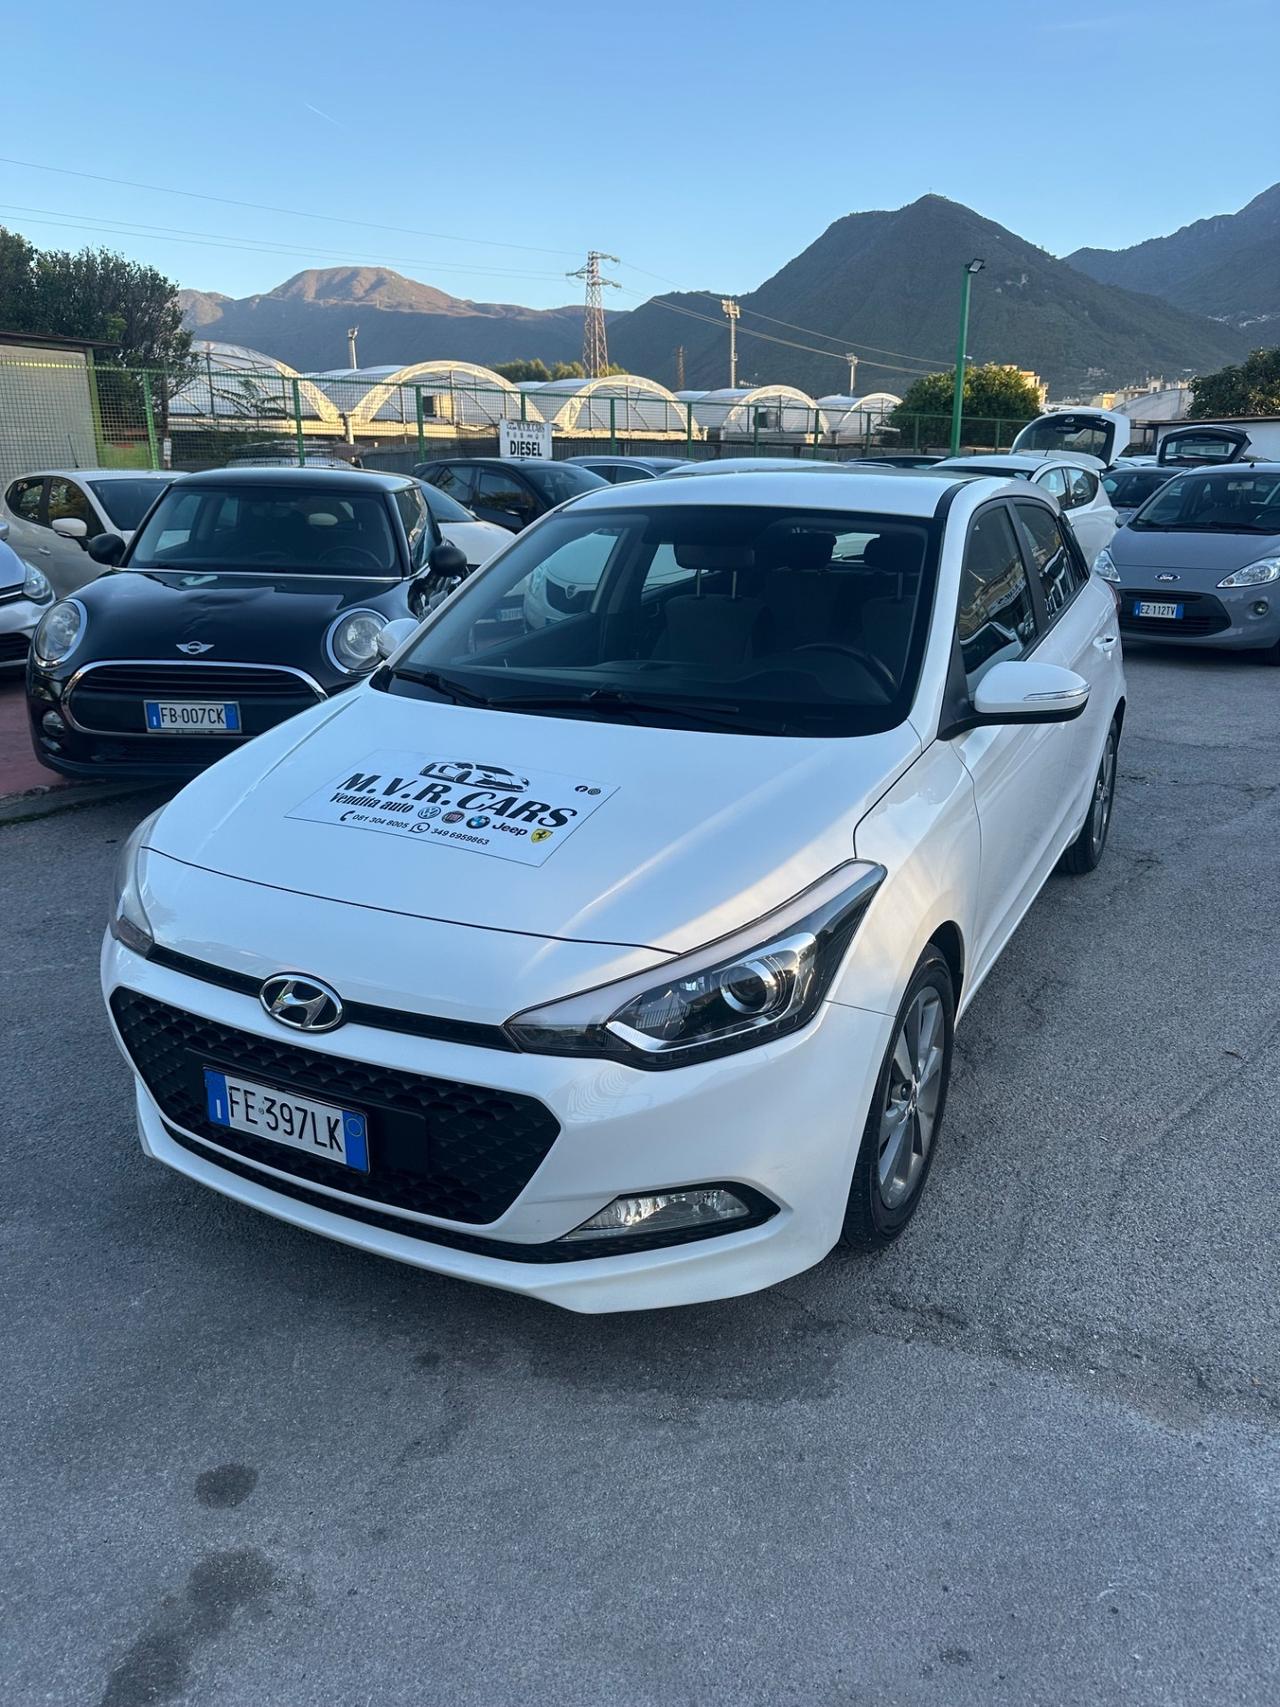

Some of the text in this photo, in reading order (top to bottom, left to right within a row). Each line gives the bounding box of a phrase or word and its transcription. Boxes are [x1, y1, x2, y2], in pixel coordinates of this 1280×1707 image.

[510, 440, 542, 457] DIESEL
[330, 792, 414, 813] Vendita auto
[336, 773, 578, 828] M.V.R. CARS
[430, 828, 490, 845] 349 6959863
[492, 822, 528, 837] Jeep
